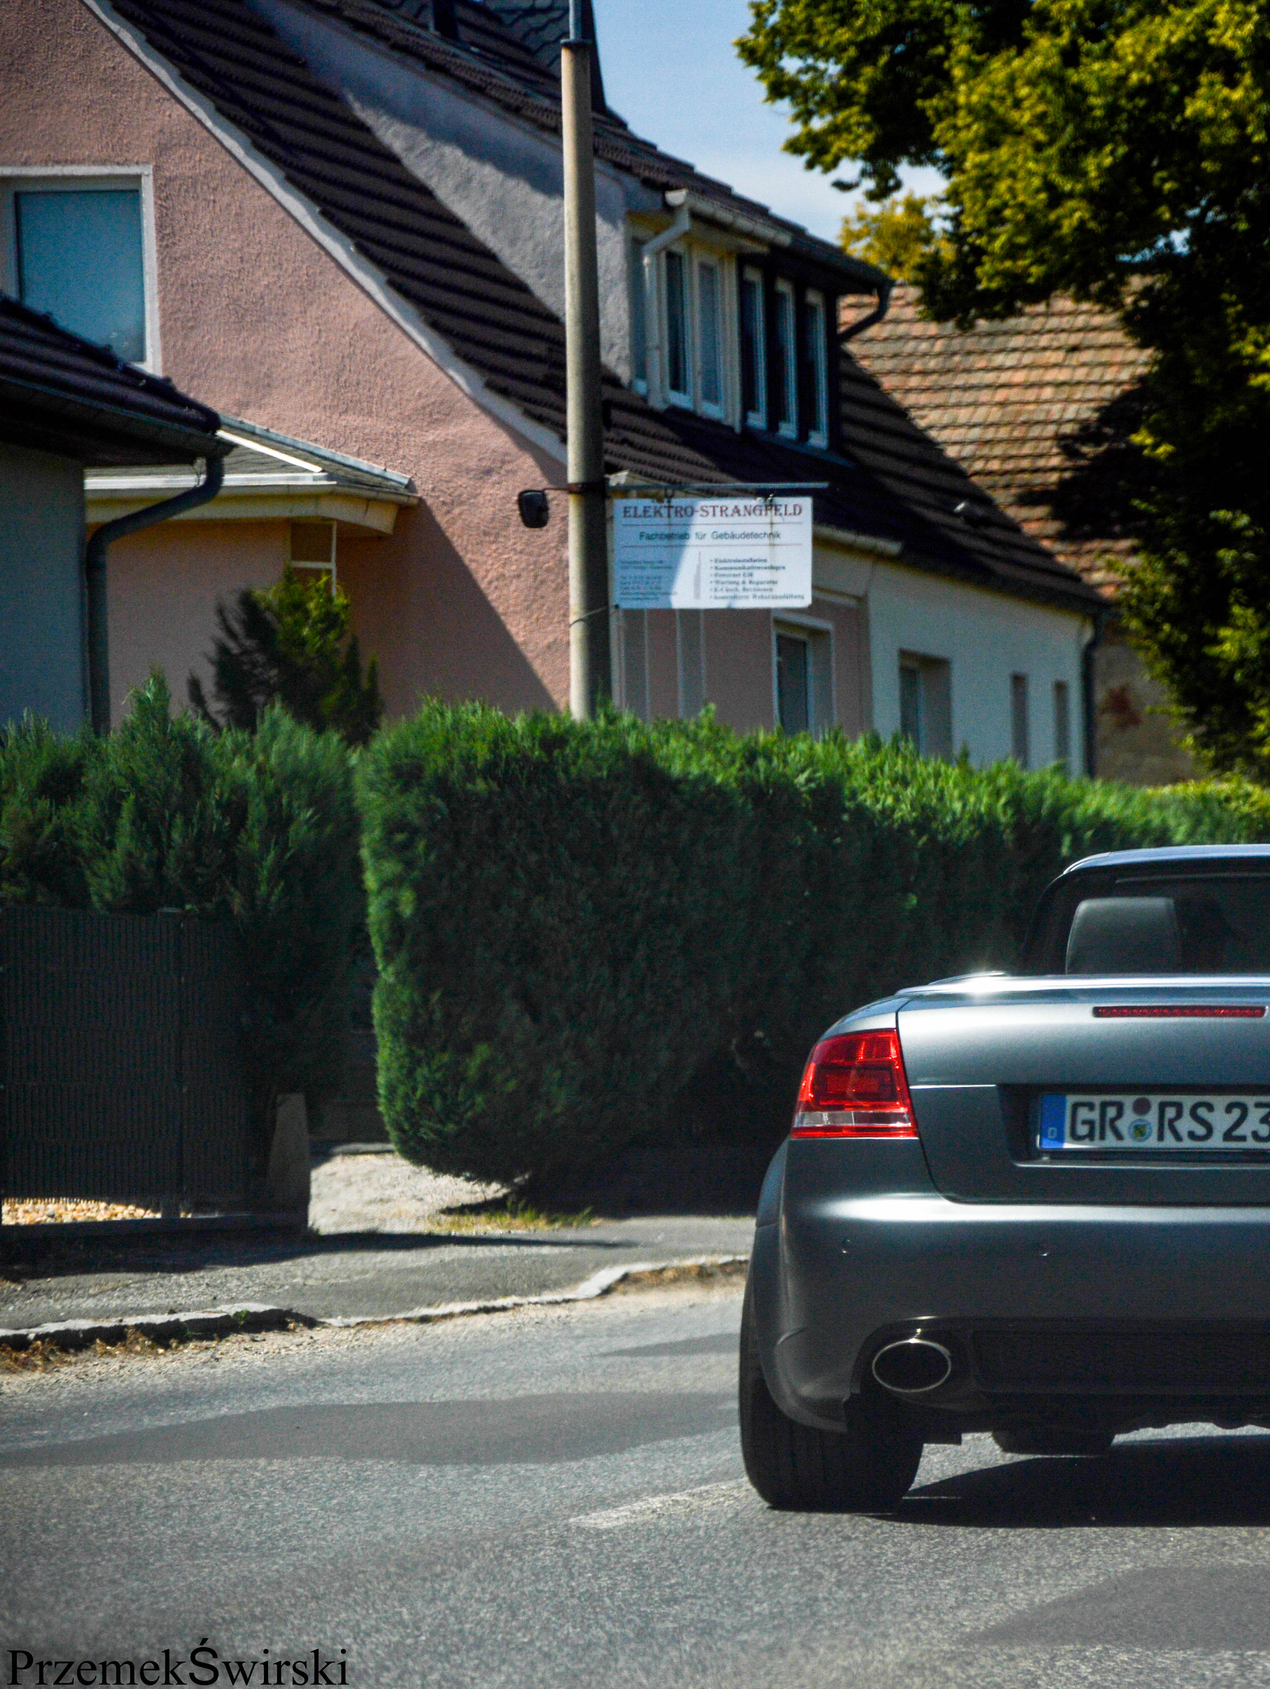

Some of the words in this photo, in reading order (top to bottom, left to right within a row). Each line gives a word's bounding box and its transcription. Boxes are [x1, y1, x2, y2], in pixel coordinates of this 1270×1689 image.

[622, 504, 803, 519] ELEKTRO-STRANGFELD
[639, 531, 690, 541] Fachbetrieb
[695, 531, 707, 540] für
[711, 530, 781, 540] Gebäudetechnik
[1070, 1101, 1124, 1141] GR
